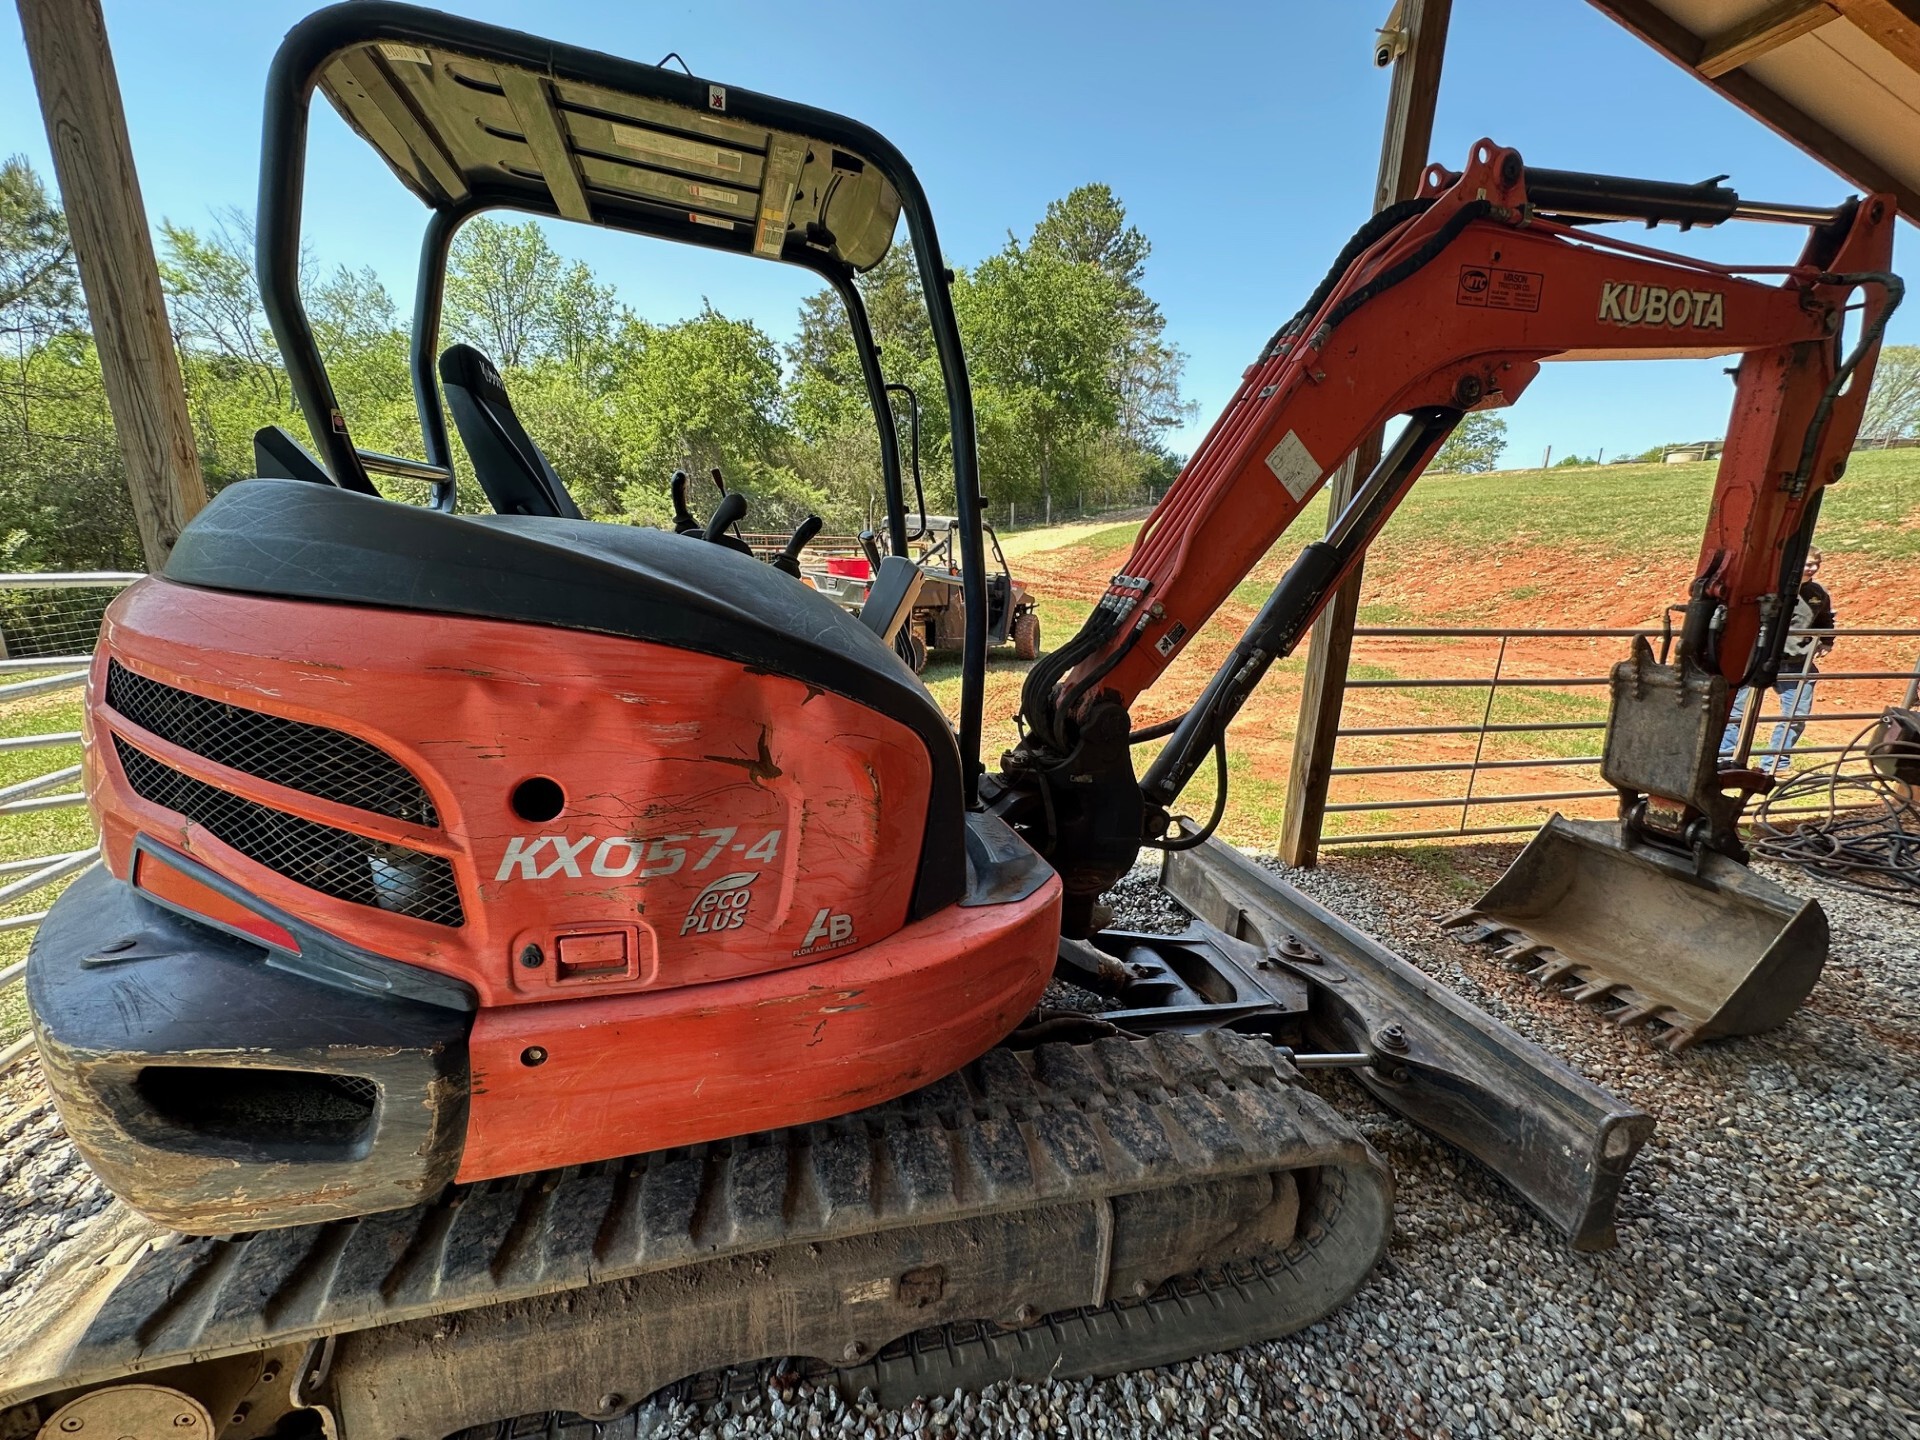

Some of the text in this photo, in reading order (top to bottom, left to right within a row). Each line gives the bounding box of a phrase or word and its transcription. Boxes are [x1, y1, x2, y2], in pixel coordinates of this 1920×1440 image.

[1498, 281, 1522, 291] TRACTOR
[1503, 273, 1528, 284] MASON
[1597, 282, 1725, 329] KUBOTA
[494, 826, 783, 882] KX057-4
[701, 889, 751, 912] eco
[680, 908, 748, 936] PLUS
[792, 936, 859, 957] FLOAT ANGLE BLADE
